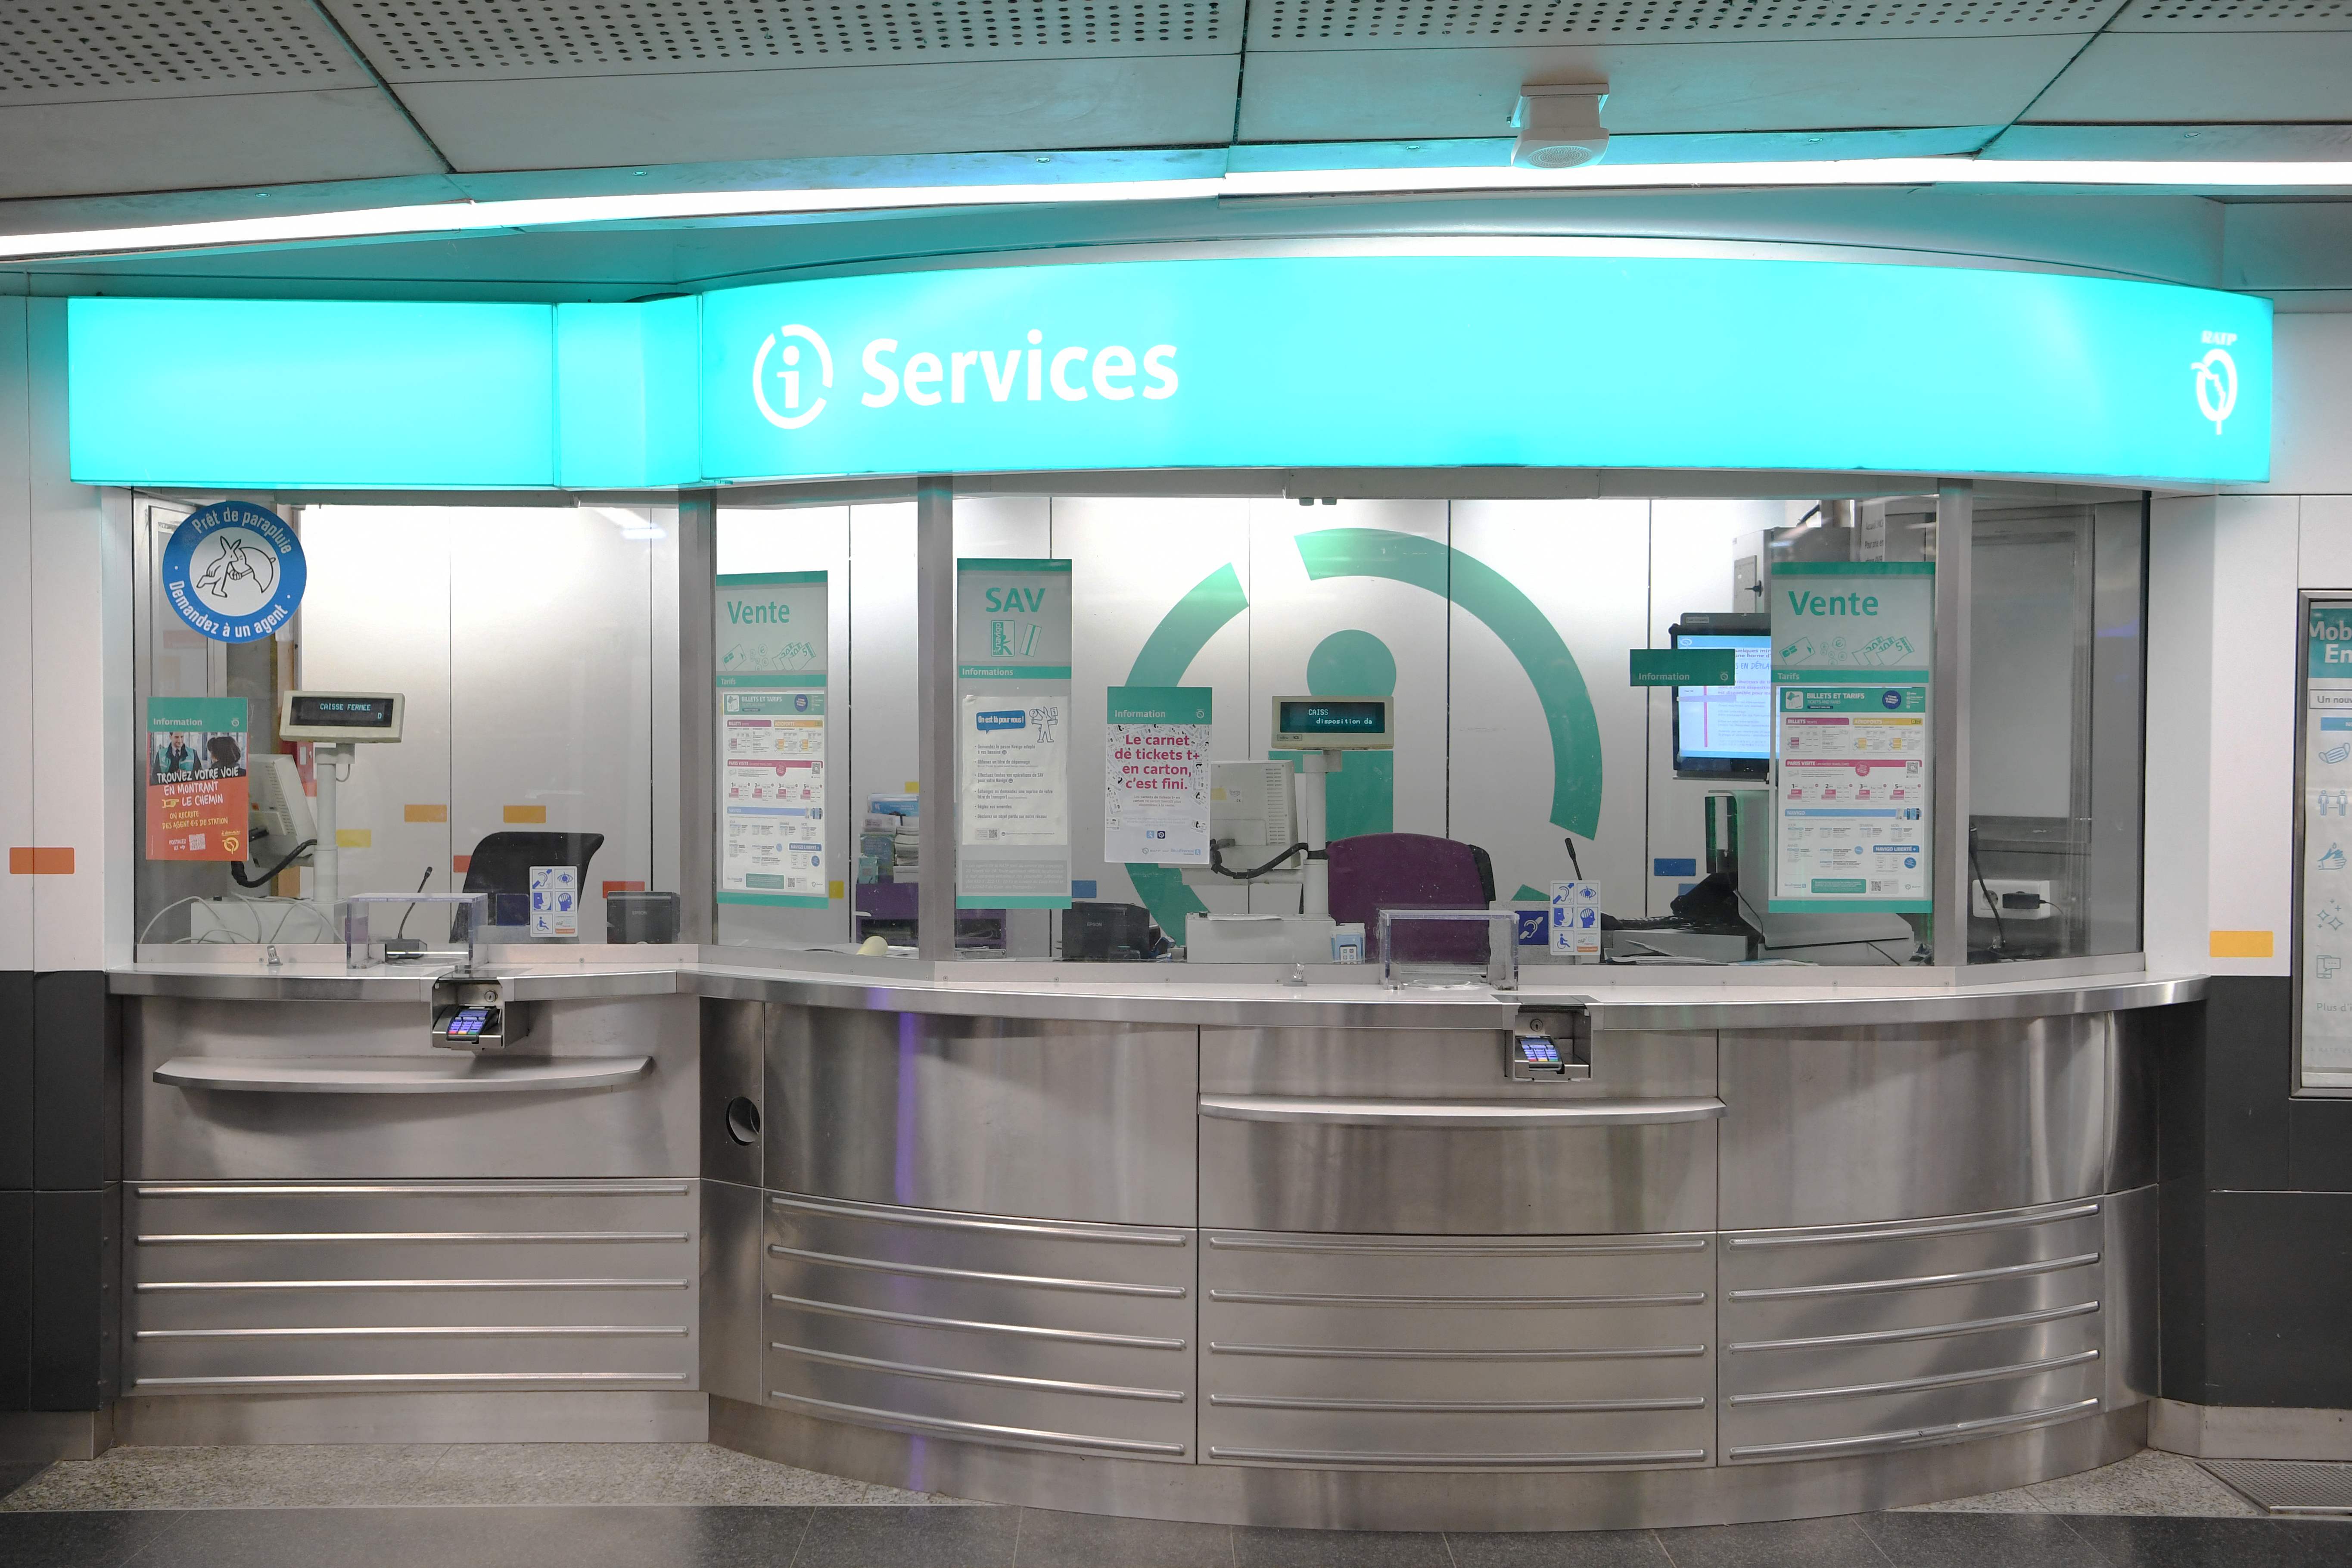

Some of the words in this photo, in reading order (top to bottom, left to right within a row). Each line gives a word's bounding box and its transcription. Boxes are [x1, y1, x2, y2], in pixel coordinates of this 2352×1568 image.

[860, 328, 1179, 408] Services
[191, 510, 220, 534] Prêt
[223, 507, 238, 522] de
[242, 511, 292, 554] parapluie
[985, 587, 1046, 613] SAV
[1788, 591, 1879, 616] Vente
[169, 580, 220, 635] Demandez
[222, 622, 230, 637] à
[235, 625, 251, 638] un
[254, 604, 288, 634] agent
[727, 601, 790, 624] Vente
[1639, 672, 1689, 681] Information
[1114, 709, 1166, 718] Information
[1126, 734, 1141, 745] Le
[1145, 735, 1190, 746] carnet
[1114, 748, 1132, 759] de
[1136, 748, 1182, 760] tickets
[1186, 750, 1200, 760] t+
[157, 771, 192, 784] TROUVEZ
[194, 768, 218, 780] VOTRE
[221, 766, 239, 778] VOIE
[1122, 765, 1139, 774] en
[1143, 764, 1192, 777] carton,
[164, 785, 174, 796] EN
[177, 781, 218, 794] MONTRANT
[1126, 778, 1158, 789] c'est
[1162, 778, 1188, 790] fini.
[182, 796, 192, 806] LE
[195, 793, 223, 806] CHEMIN
[162, 821, 172, 829] DES
[208, 817, 228, 825] STATION
[2317, 1003, 2337, 1011] Plus
